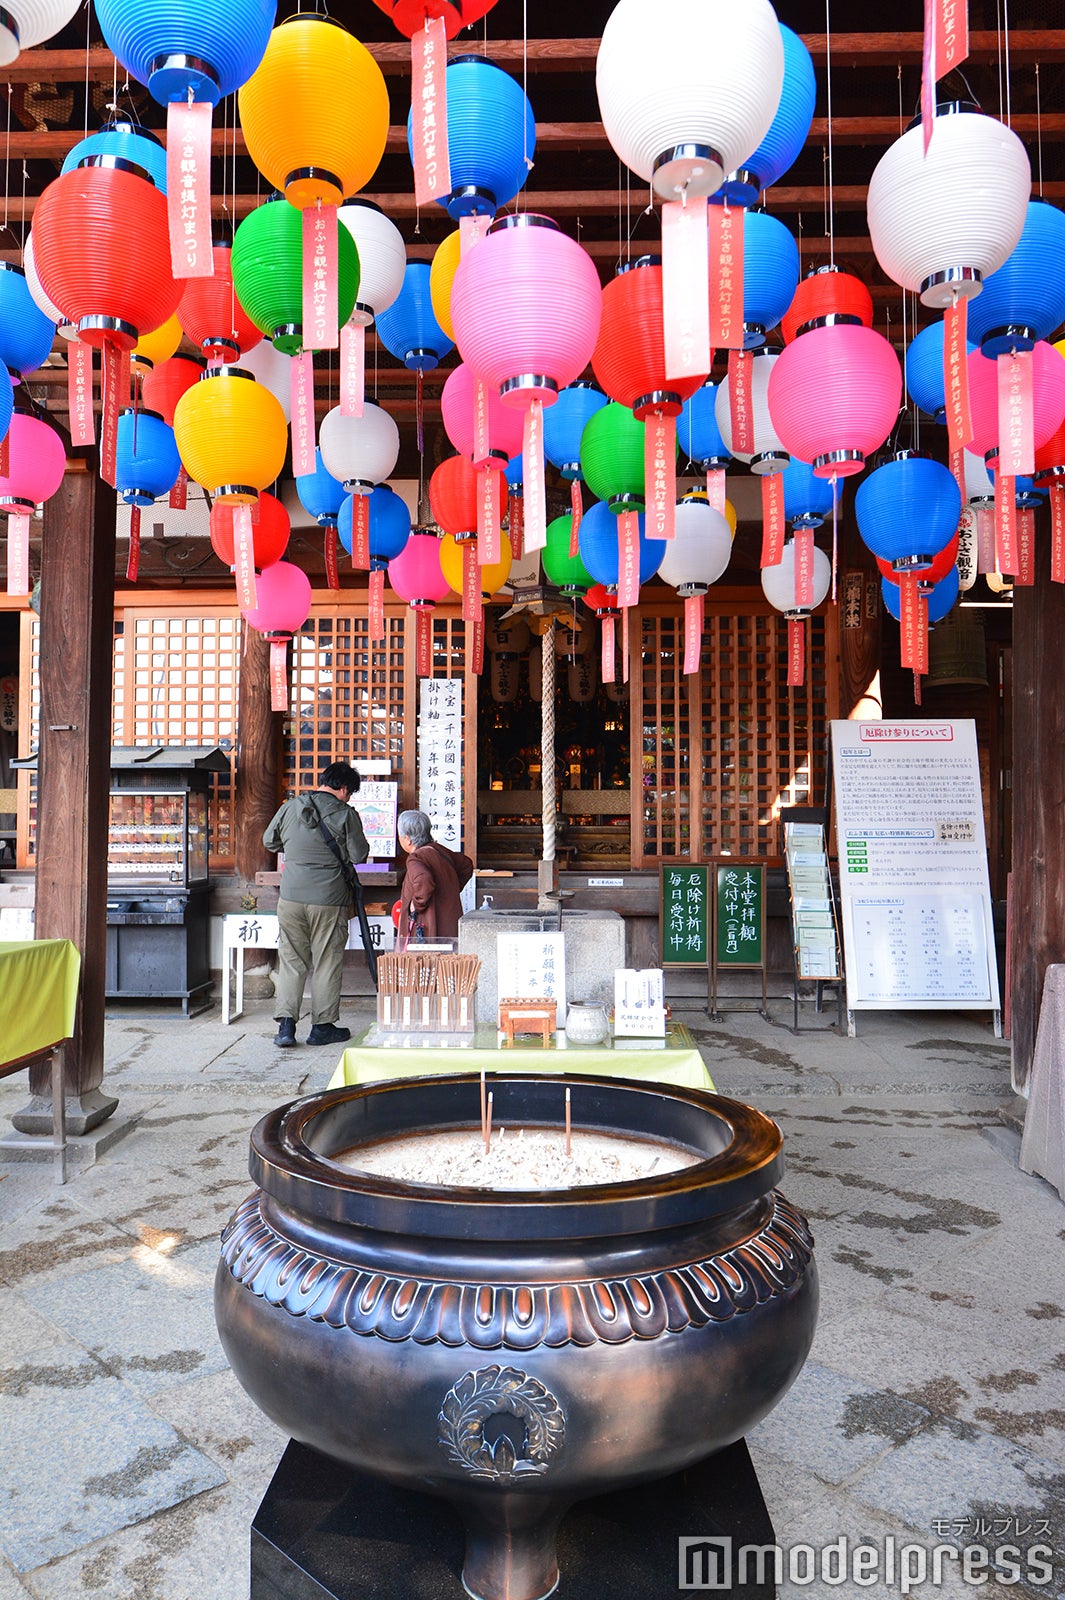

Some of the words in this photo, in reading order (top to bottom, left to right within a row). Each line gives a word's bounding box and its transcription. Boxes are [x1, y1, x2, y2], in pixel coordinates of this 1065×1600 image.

[421, 40, 437, 190] おふさ観音提灯まつり
[180, 116, 197, 268] おふさ観音提灯まつり
[312, 218, 328, 342] おふさ観音提灯まつり
[719, 217, 734, 340] おふさ観音提灯まつり
[76, 350, 86, 440] おふさ観音提灯まつり
[735, 360, 746, 449] おふさ観音提灯まつり
[951, 315, 963, 439] おふさ観音提灯まつり
[1009, 364, 1022, 469] おふさ観音提灯まつり
[484, 479, 493, 560] おふさ観音提灯まつり
[654, 427, 667, 532] おふさ観音提灯まつり
[769, 483, 778, 562] おふさ観音提灯まつり
[1001, 478, 1011, 569] おふさ観音提灯まつり
[239, 514, 250, 605] おふさ観音提灯まつり
[625, 520, 634, 602] おふさ観音提灯まつり
[957, 528, 973, 580] おふさ観音
[865, 728, 948, 738] 厄除け参りについて
[668, 872, 685, 952] 毎日受付中
[685, 873, 704, 952] 厄除け祈祷
[738, 871, 757, 941] 本堂拝観
